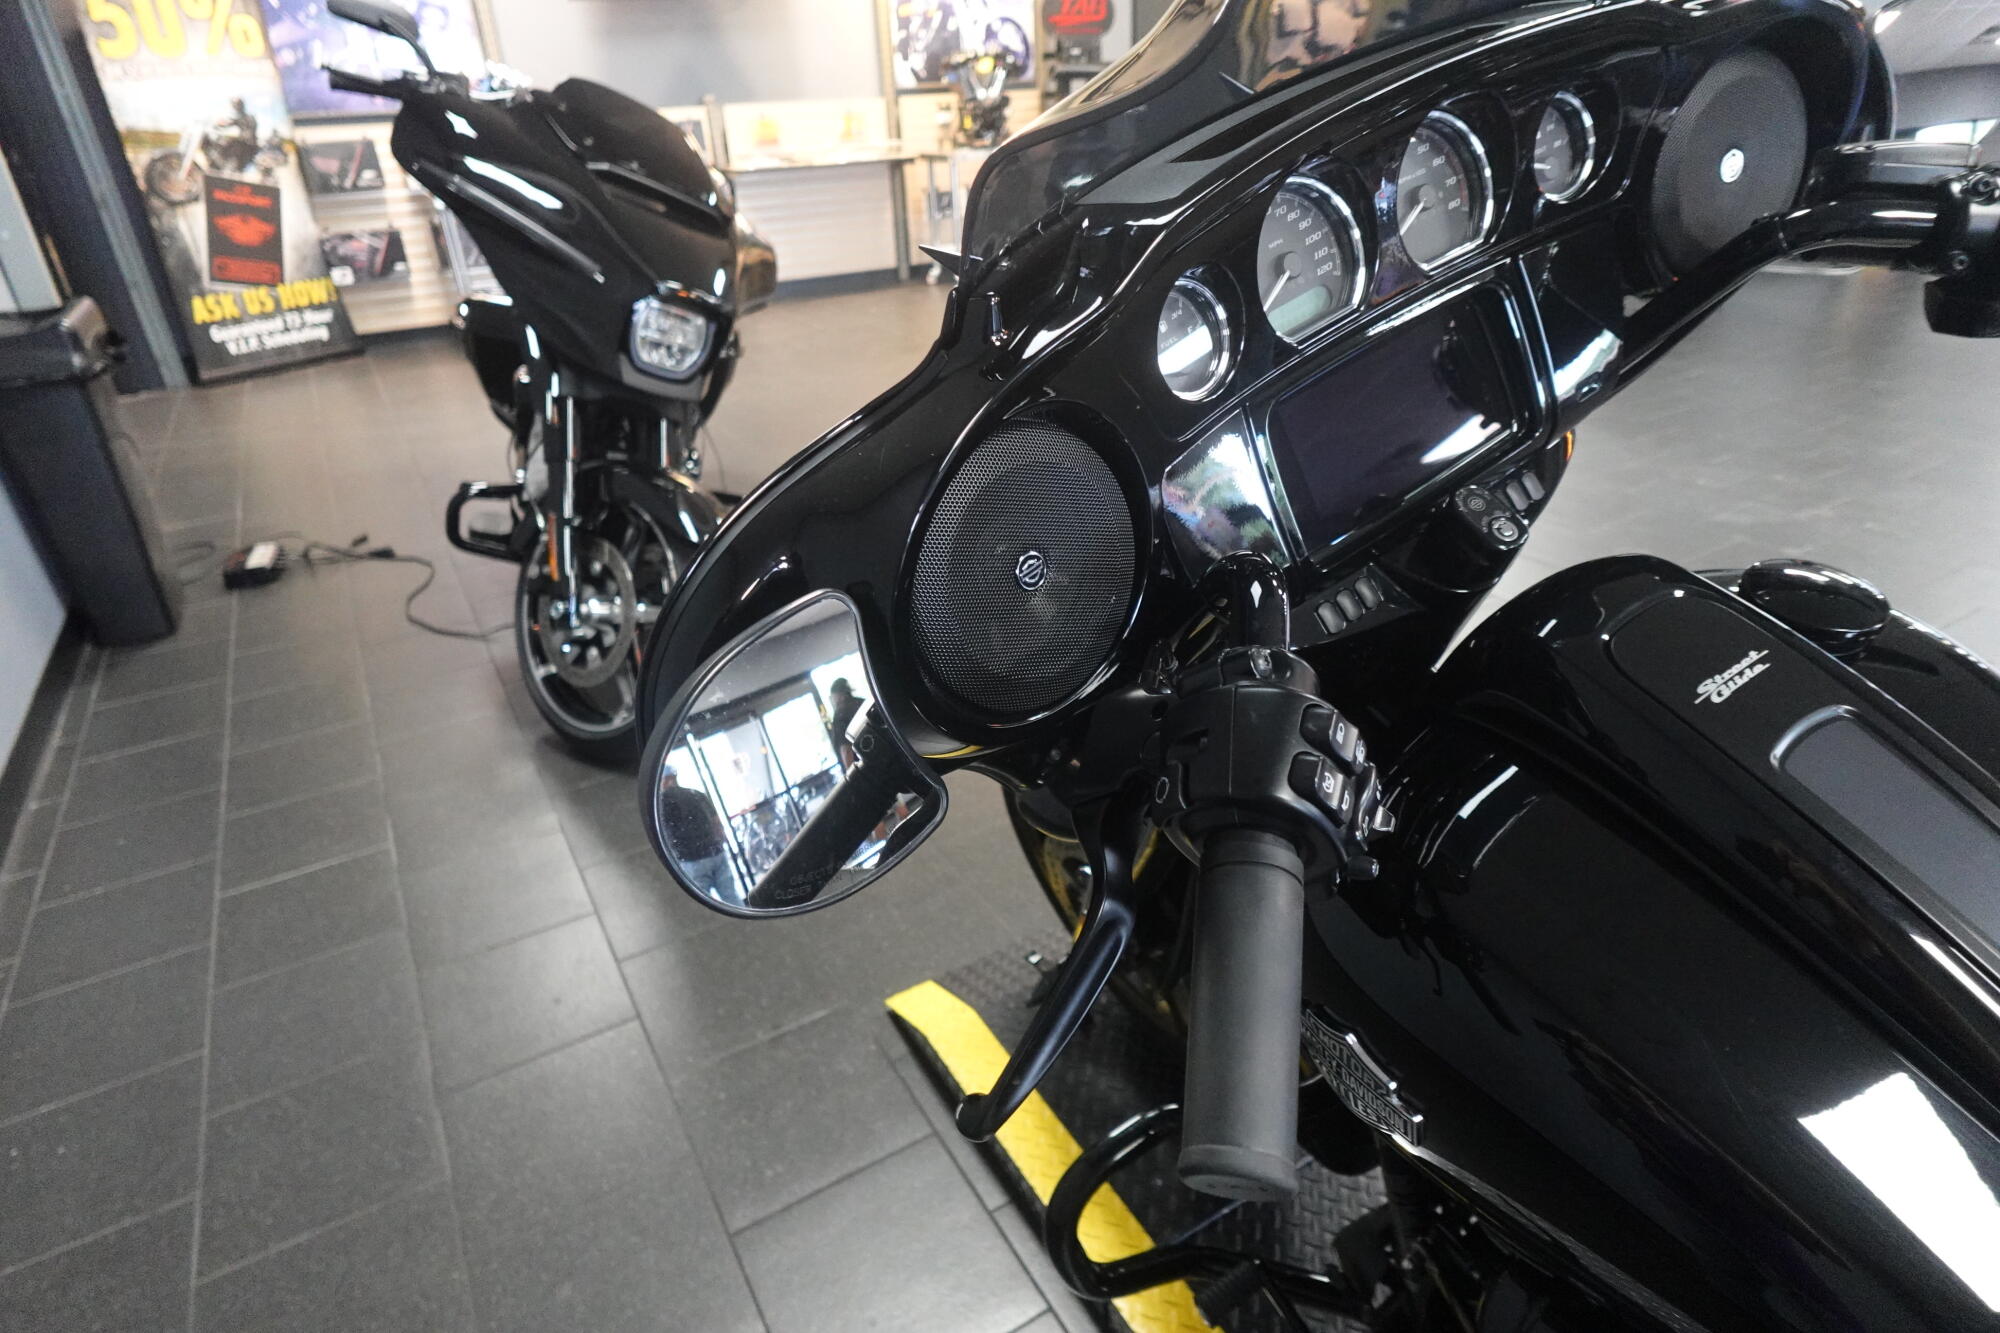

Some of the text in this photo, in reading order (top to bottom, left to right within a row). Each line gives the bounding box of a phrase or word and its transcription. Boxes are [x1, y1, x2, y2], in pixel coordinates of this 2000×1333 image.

[87, 0, 266, 60] 50%
[1432, 155, 1446, 168] 60
[1445, 176, 1457, 188] 70
[1274, 205, 1287, 217] 70
[1287, 210, 1300, 222] 80
[1298, 218, 1312, 231] 90
[1305, 231, 1322, 246] 100
[1314, 246, 1329, 260] 110
[1317, 262, 1333, 276] 120
[191, 275, 338, 325] ASK US NOW!
[1695, 650, 1762, 698] Street
[1710, 663, 1768, 704] Glide
